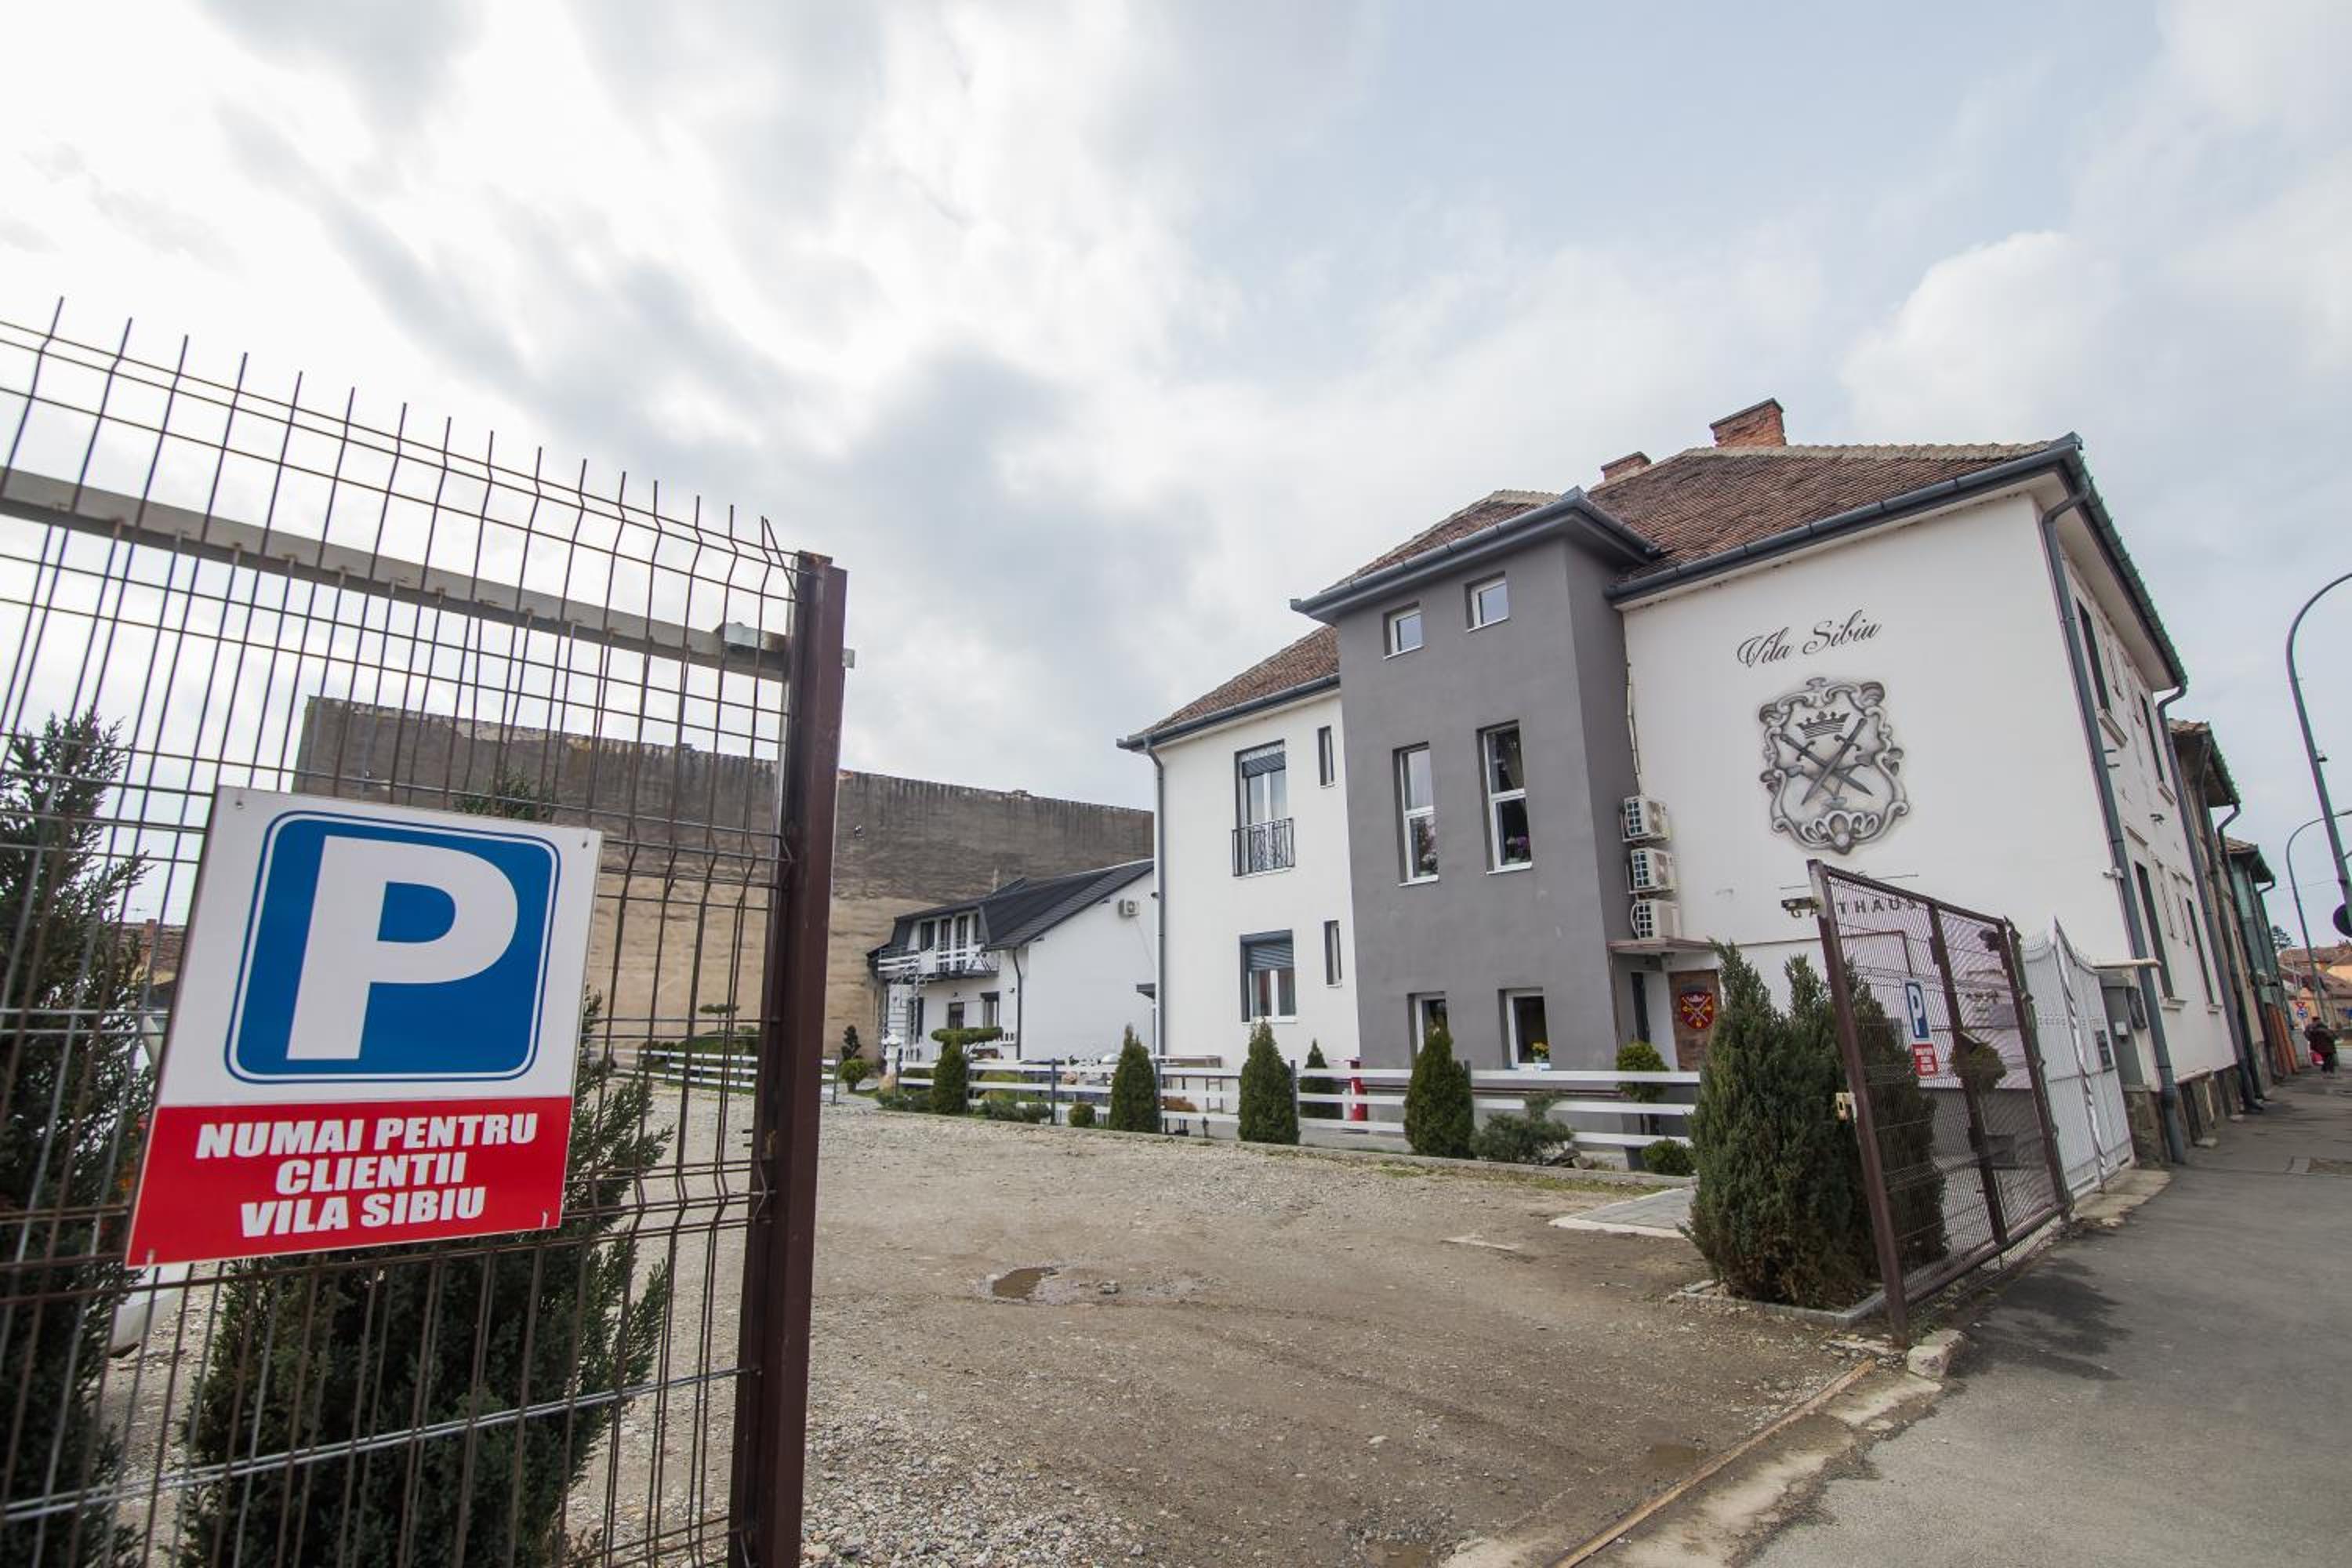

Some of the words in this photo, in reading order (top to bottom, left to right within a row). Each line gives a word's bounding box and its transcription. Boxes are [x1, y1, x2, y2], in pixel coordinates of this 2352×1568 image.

[1737, 626, 1794, 668] Vila
[1802, 609, 1882, 655] Sibiu
[285, 834, 519, 1061] P
[1907, 985, 1924, 1036] P
[195, 1120, 365, 1160] NUMAI
[374, 1112, 538, 1151] PENTRU
[275, 1152, 467, 1195] CLIENTII
[241, 1196, 349, 1238] VILA
[360, 1186, 486, 1228] SIBIU
